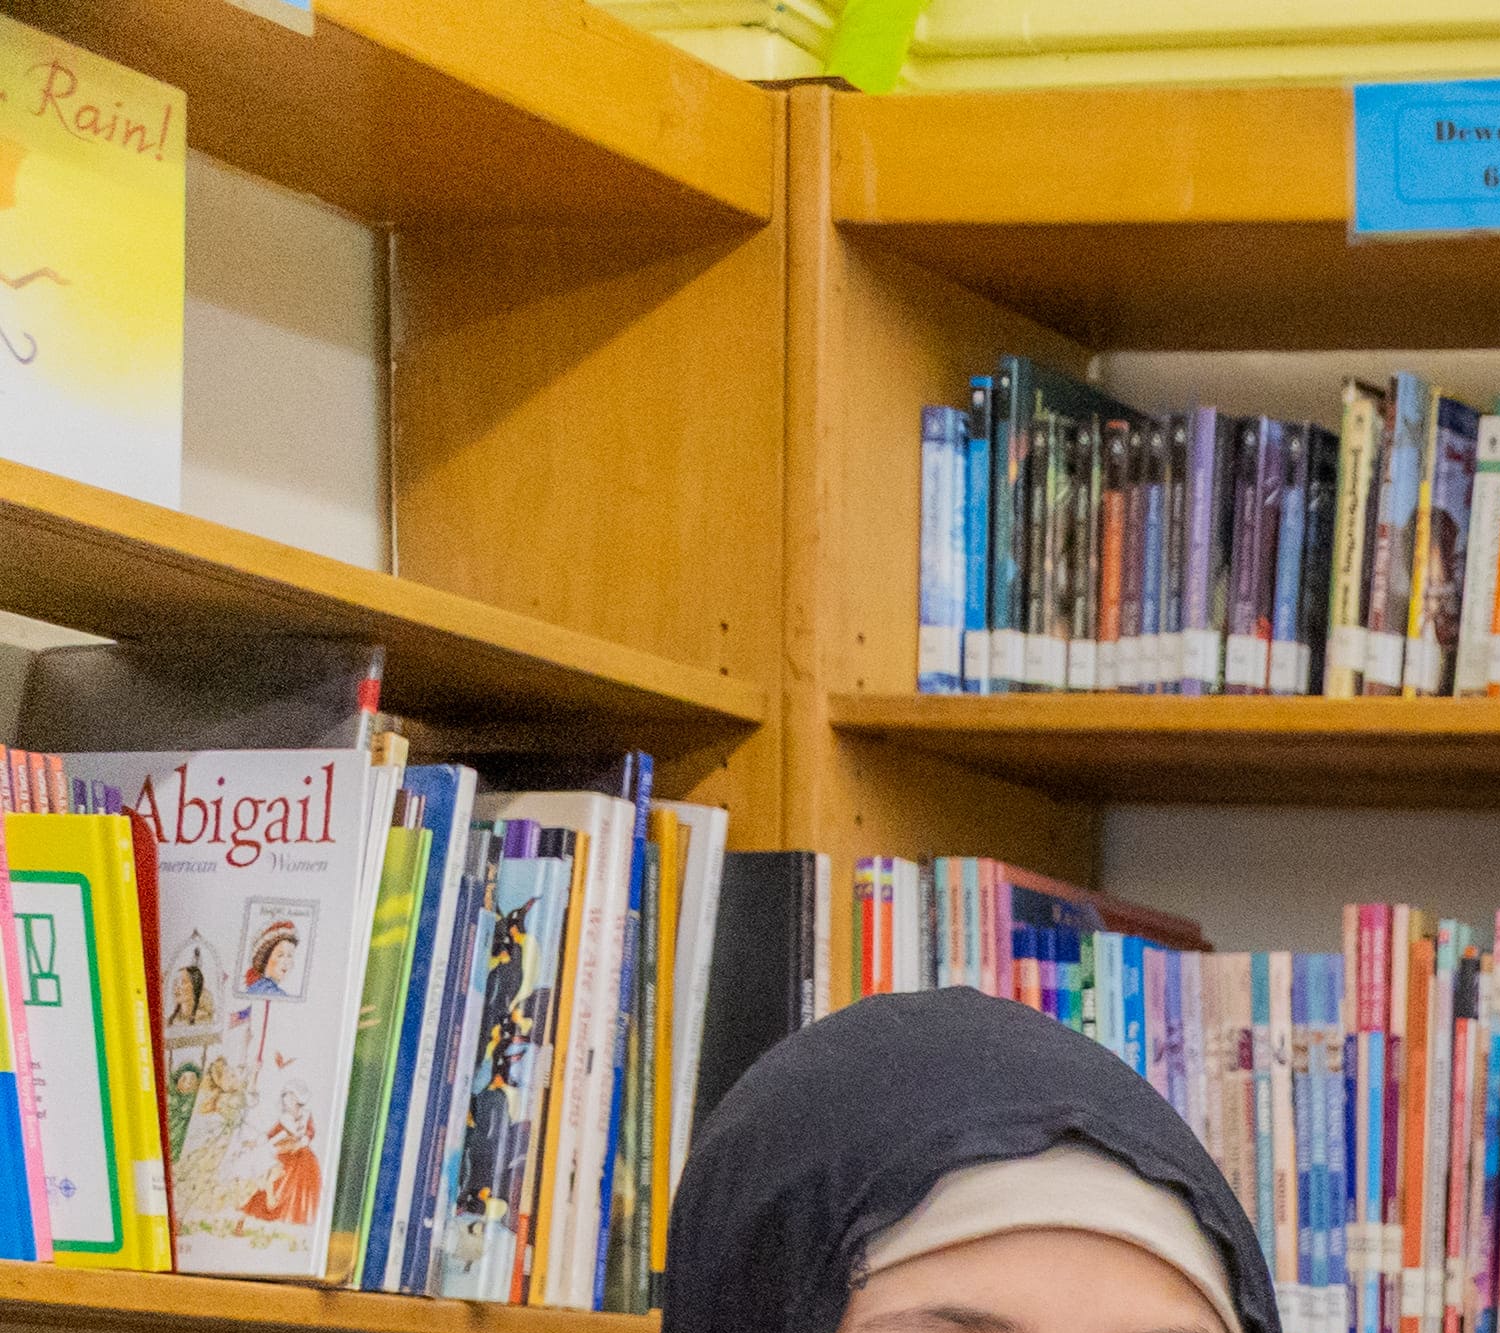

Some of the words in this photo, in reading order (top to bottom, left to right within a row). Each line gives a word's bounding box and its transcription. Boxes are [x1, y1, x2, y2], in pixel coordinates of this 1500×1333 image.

[25, 61, 172, 162] Rain!
[134, 761, 336, 868] Abigail
[160, 858, 218, 873] merican
[270, 852, 328, 873] Women
